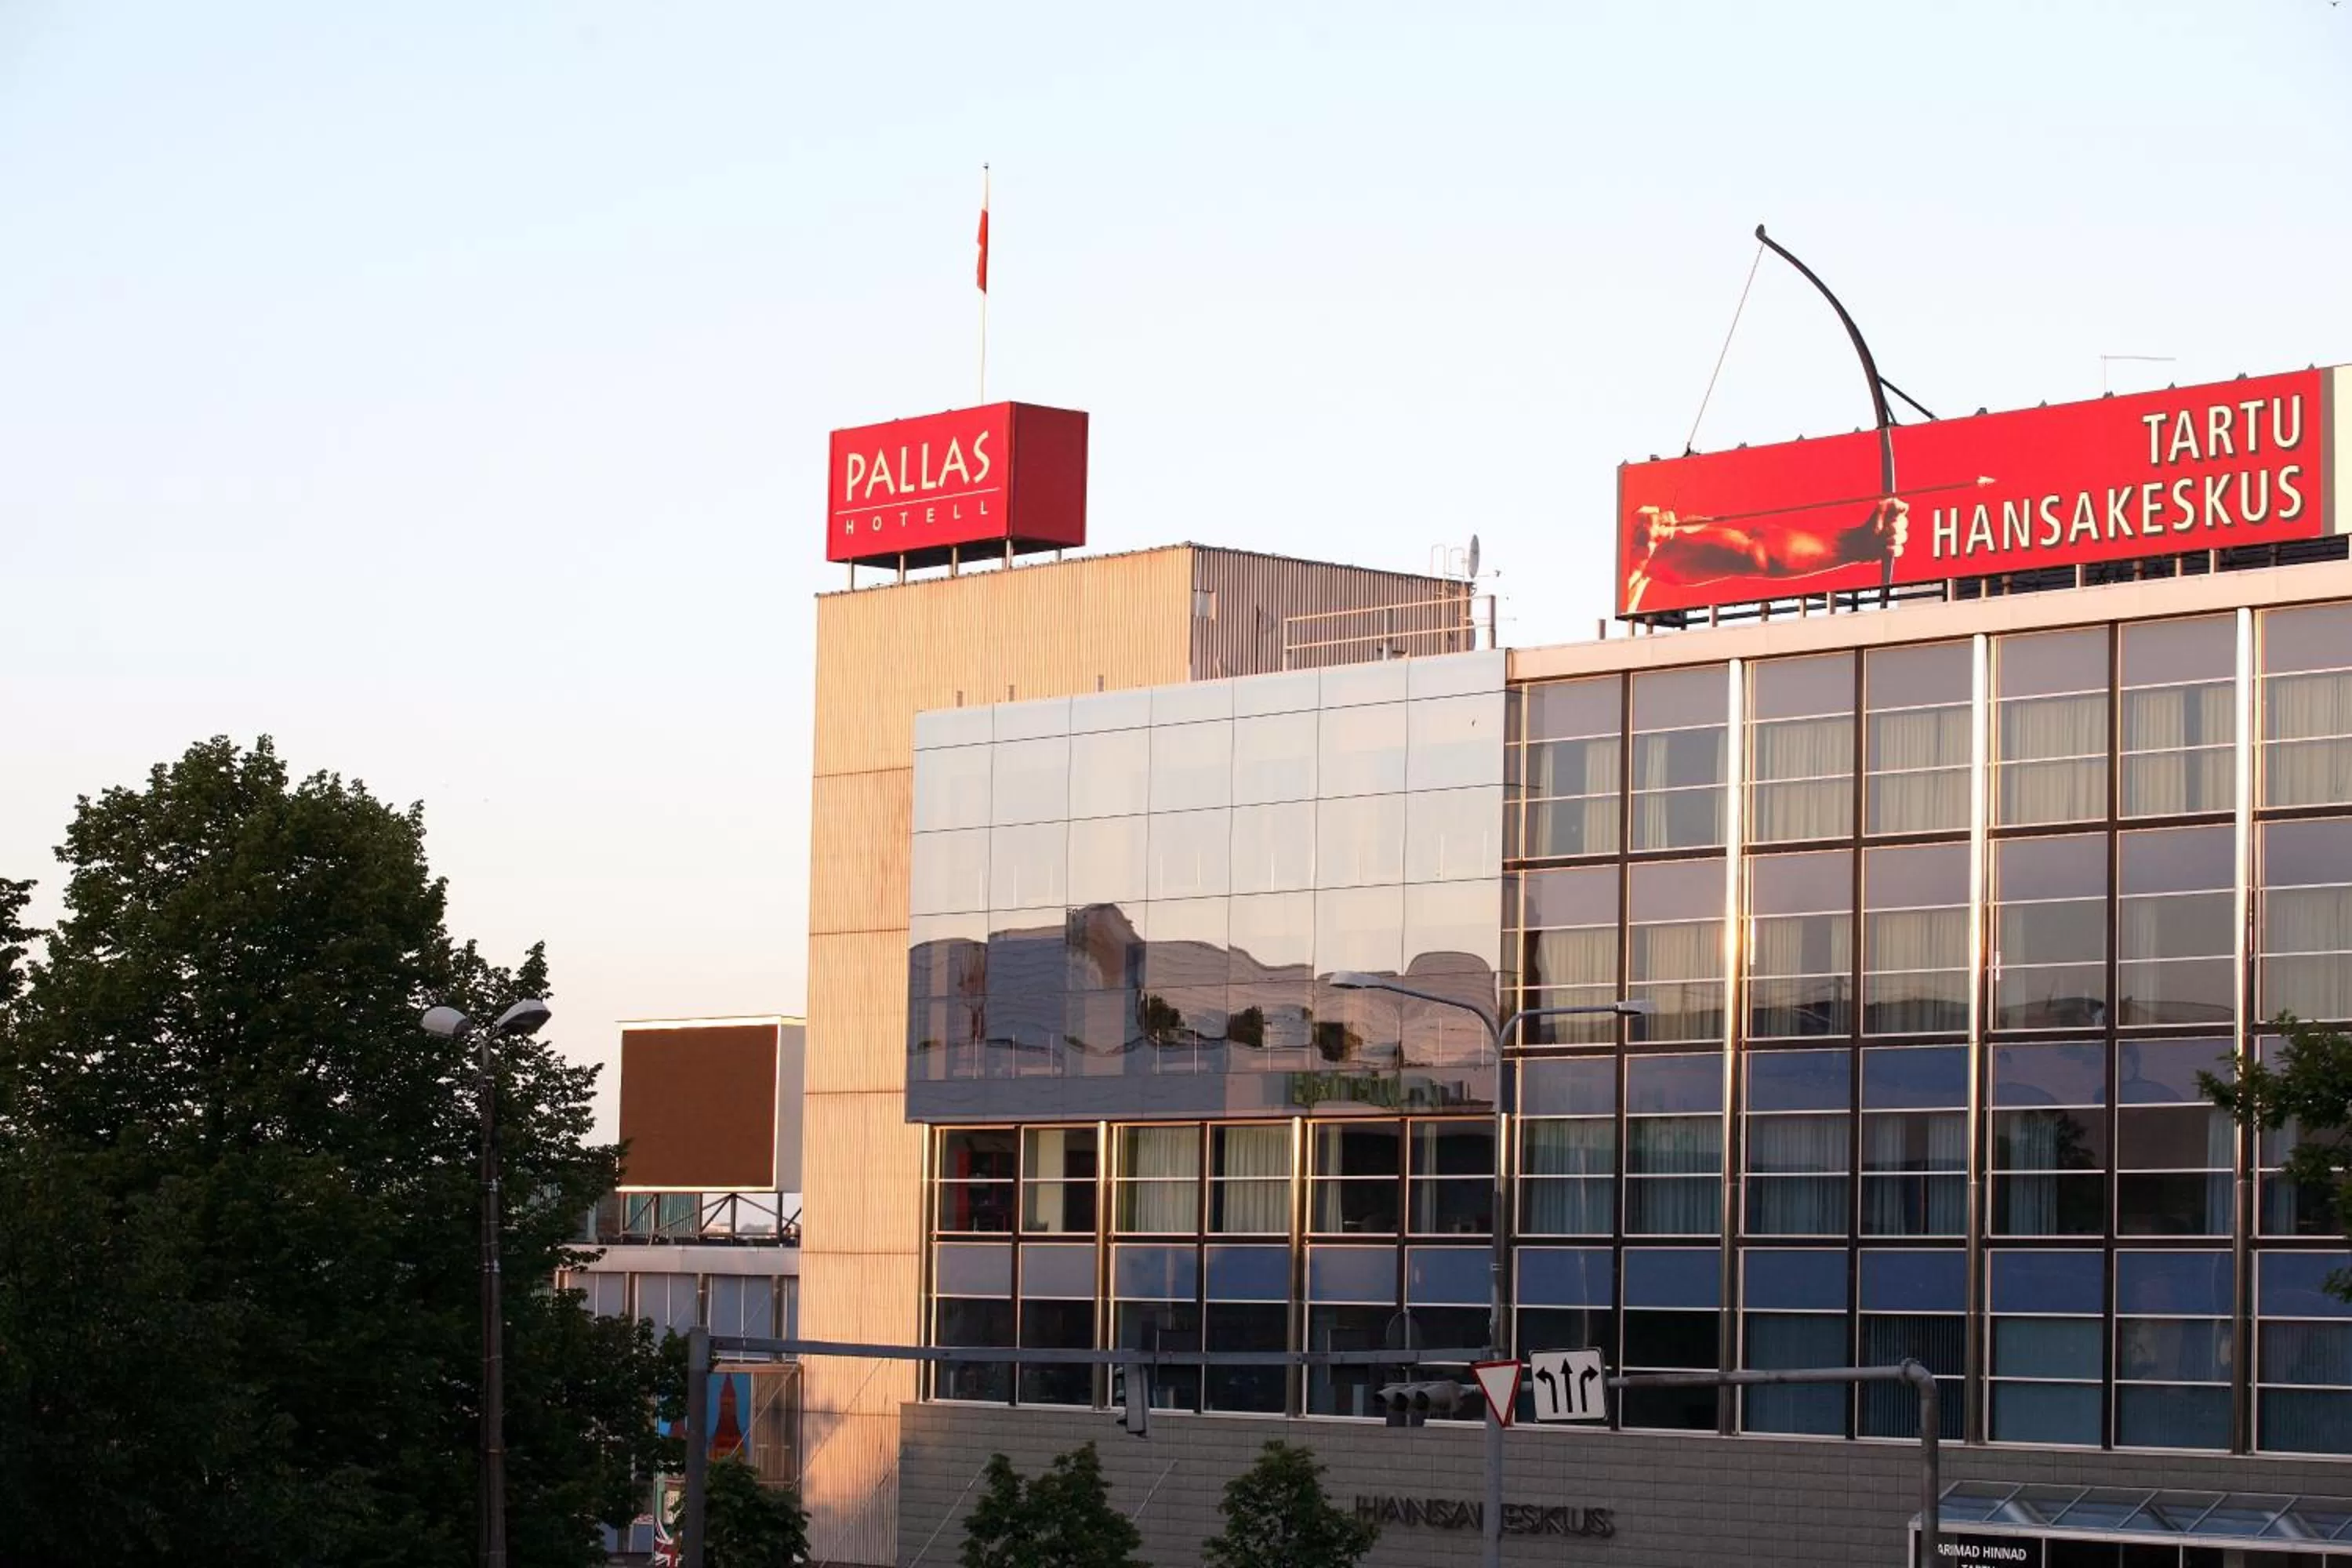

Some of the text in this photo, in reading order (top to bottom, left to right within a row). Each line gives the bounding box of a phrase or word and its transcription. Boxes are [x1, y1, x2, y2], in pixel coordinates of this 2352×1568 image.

[2142, 394, 2303, 465] TARTU
[846, 430, 991, 502] PALLAS
[845, 501, 988, 535] HOTELL
[1933, 464, 2305, 559] HANSAKESKUS
[1936, 1543, 2027, 1561] ARIMAD HINNAD
